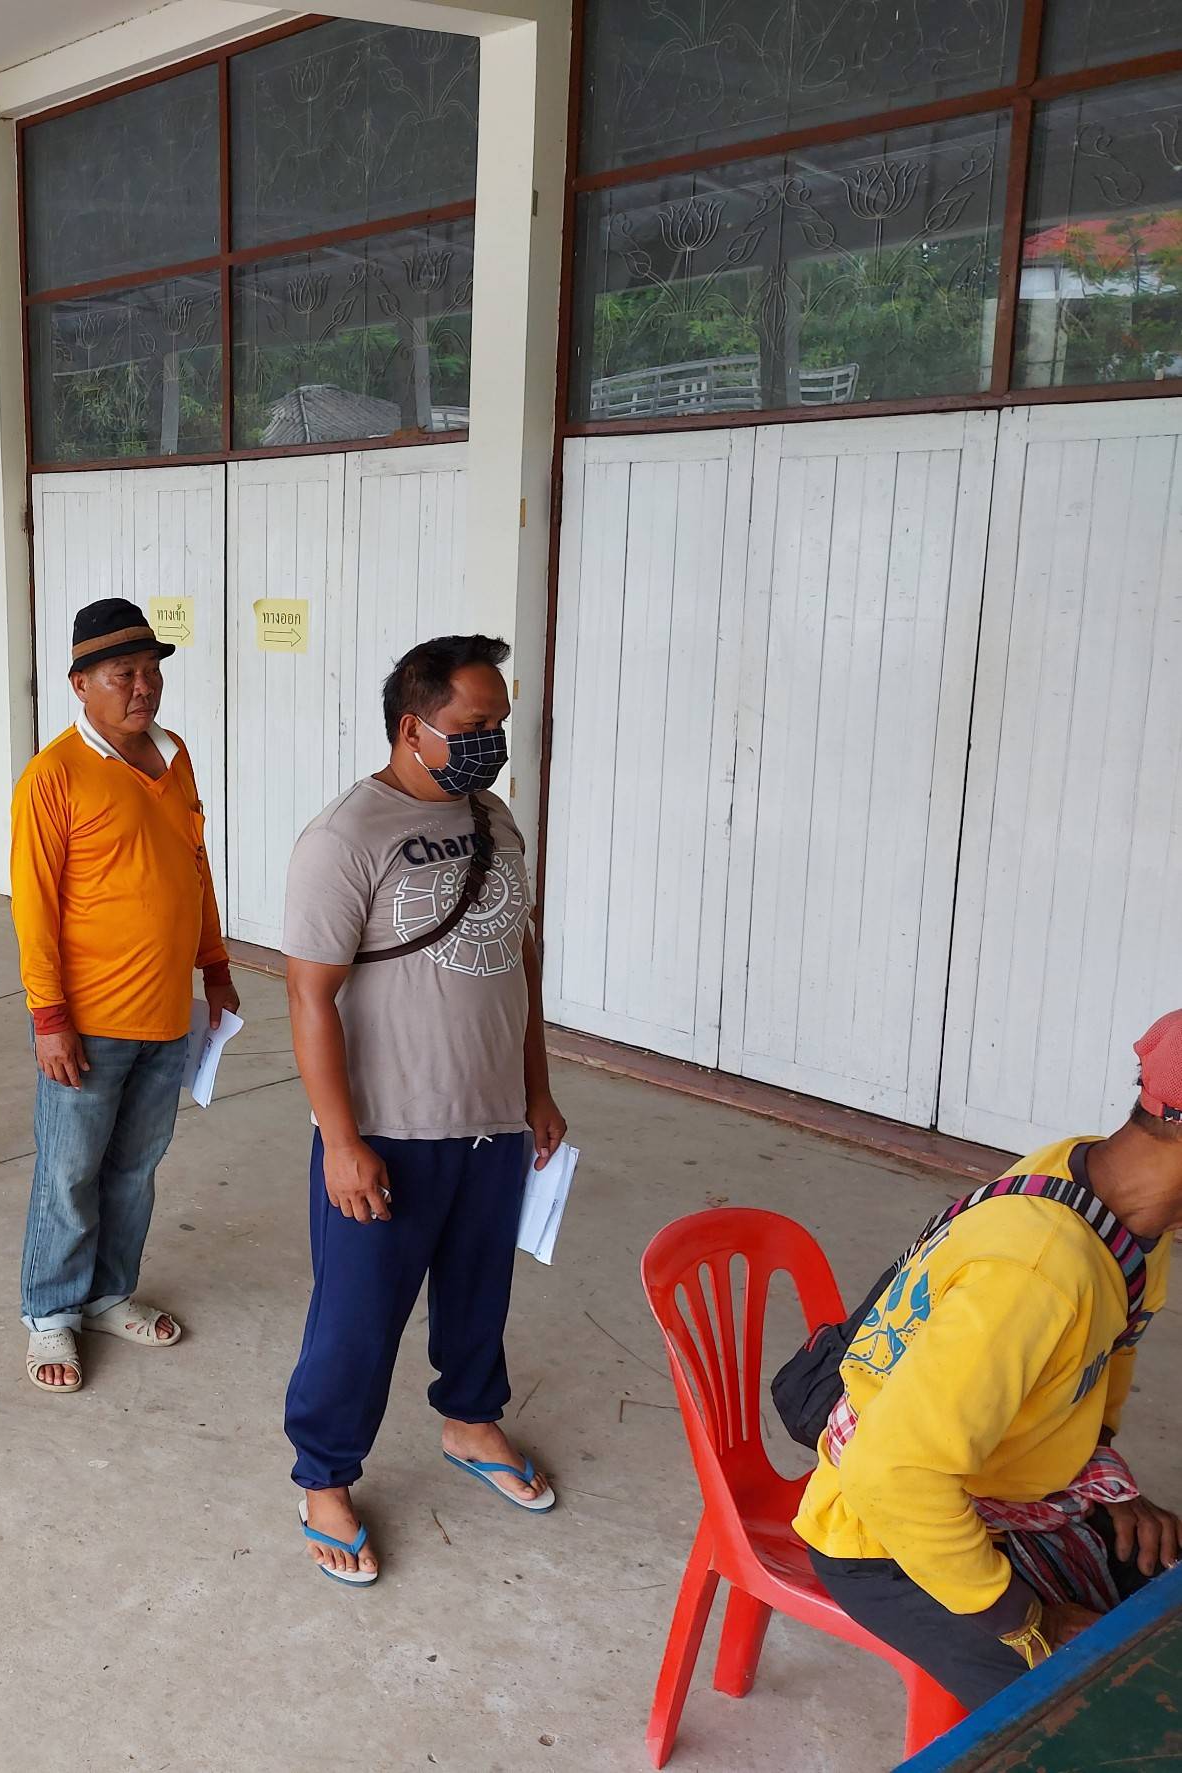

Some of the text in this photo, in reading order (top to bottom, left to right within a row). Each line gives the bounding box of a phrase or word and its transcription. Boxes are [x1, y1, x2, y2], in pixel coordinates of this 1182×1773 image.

[157, 603, 186, 621] ทางเข้า
[263, 612, 301, 625] ทางออก
[440, 863, 459, 895] FOR
[441, 898, 516, 937] SESSFUL
